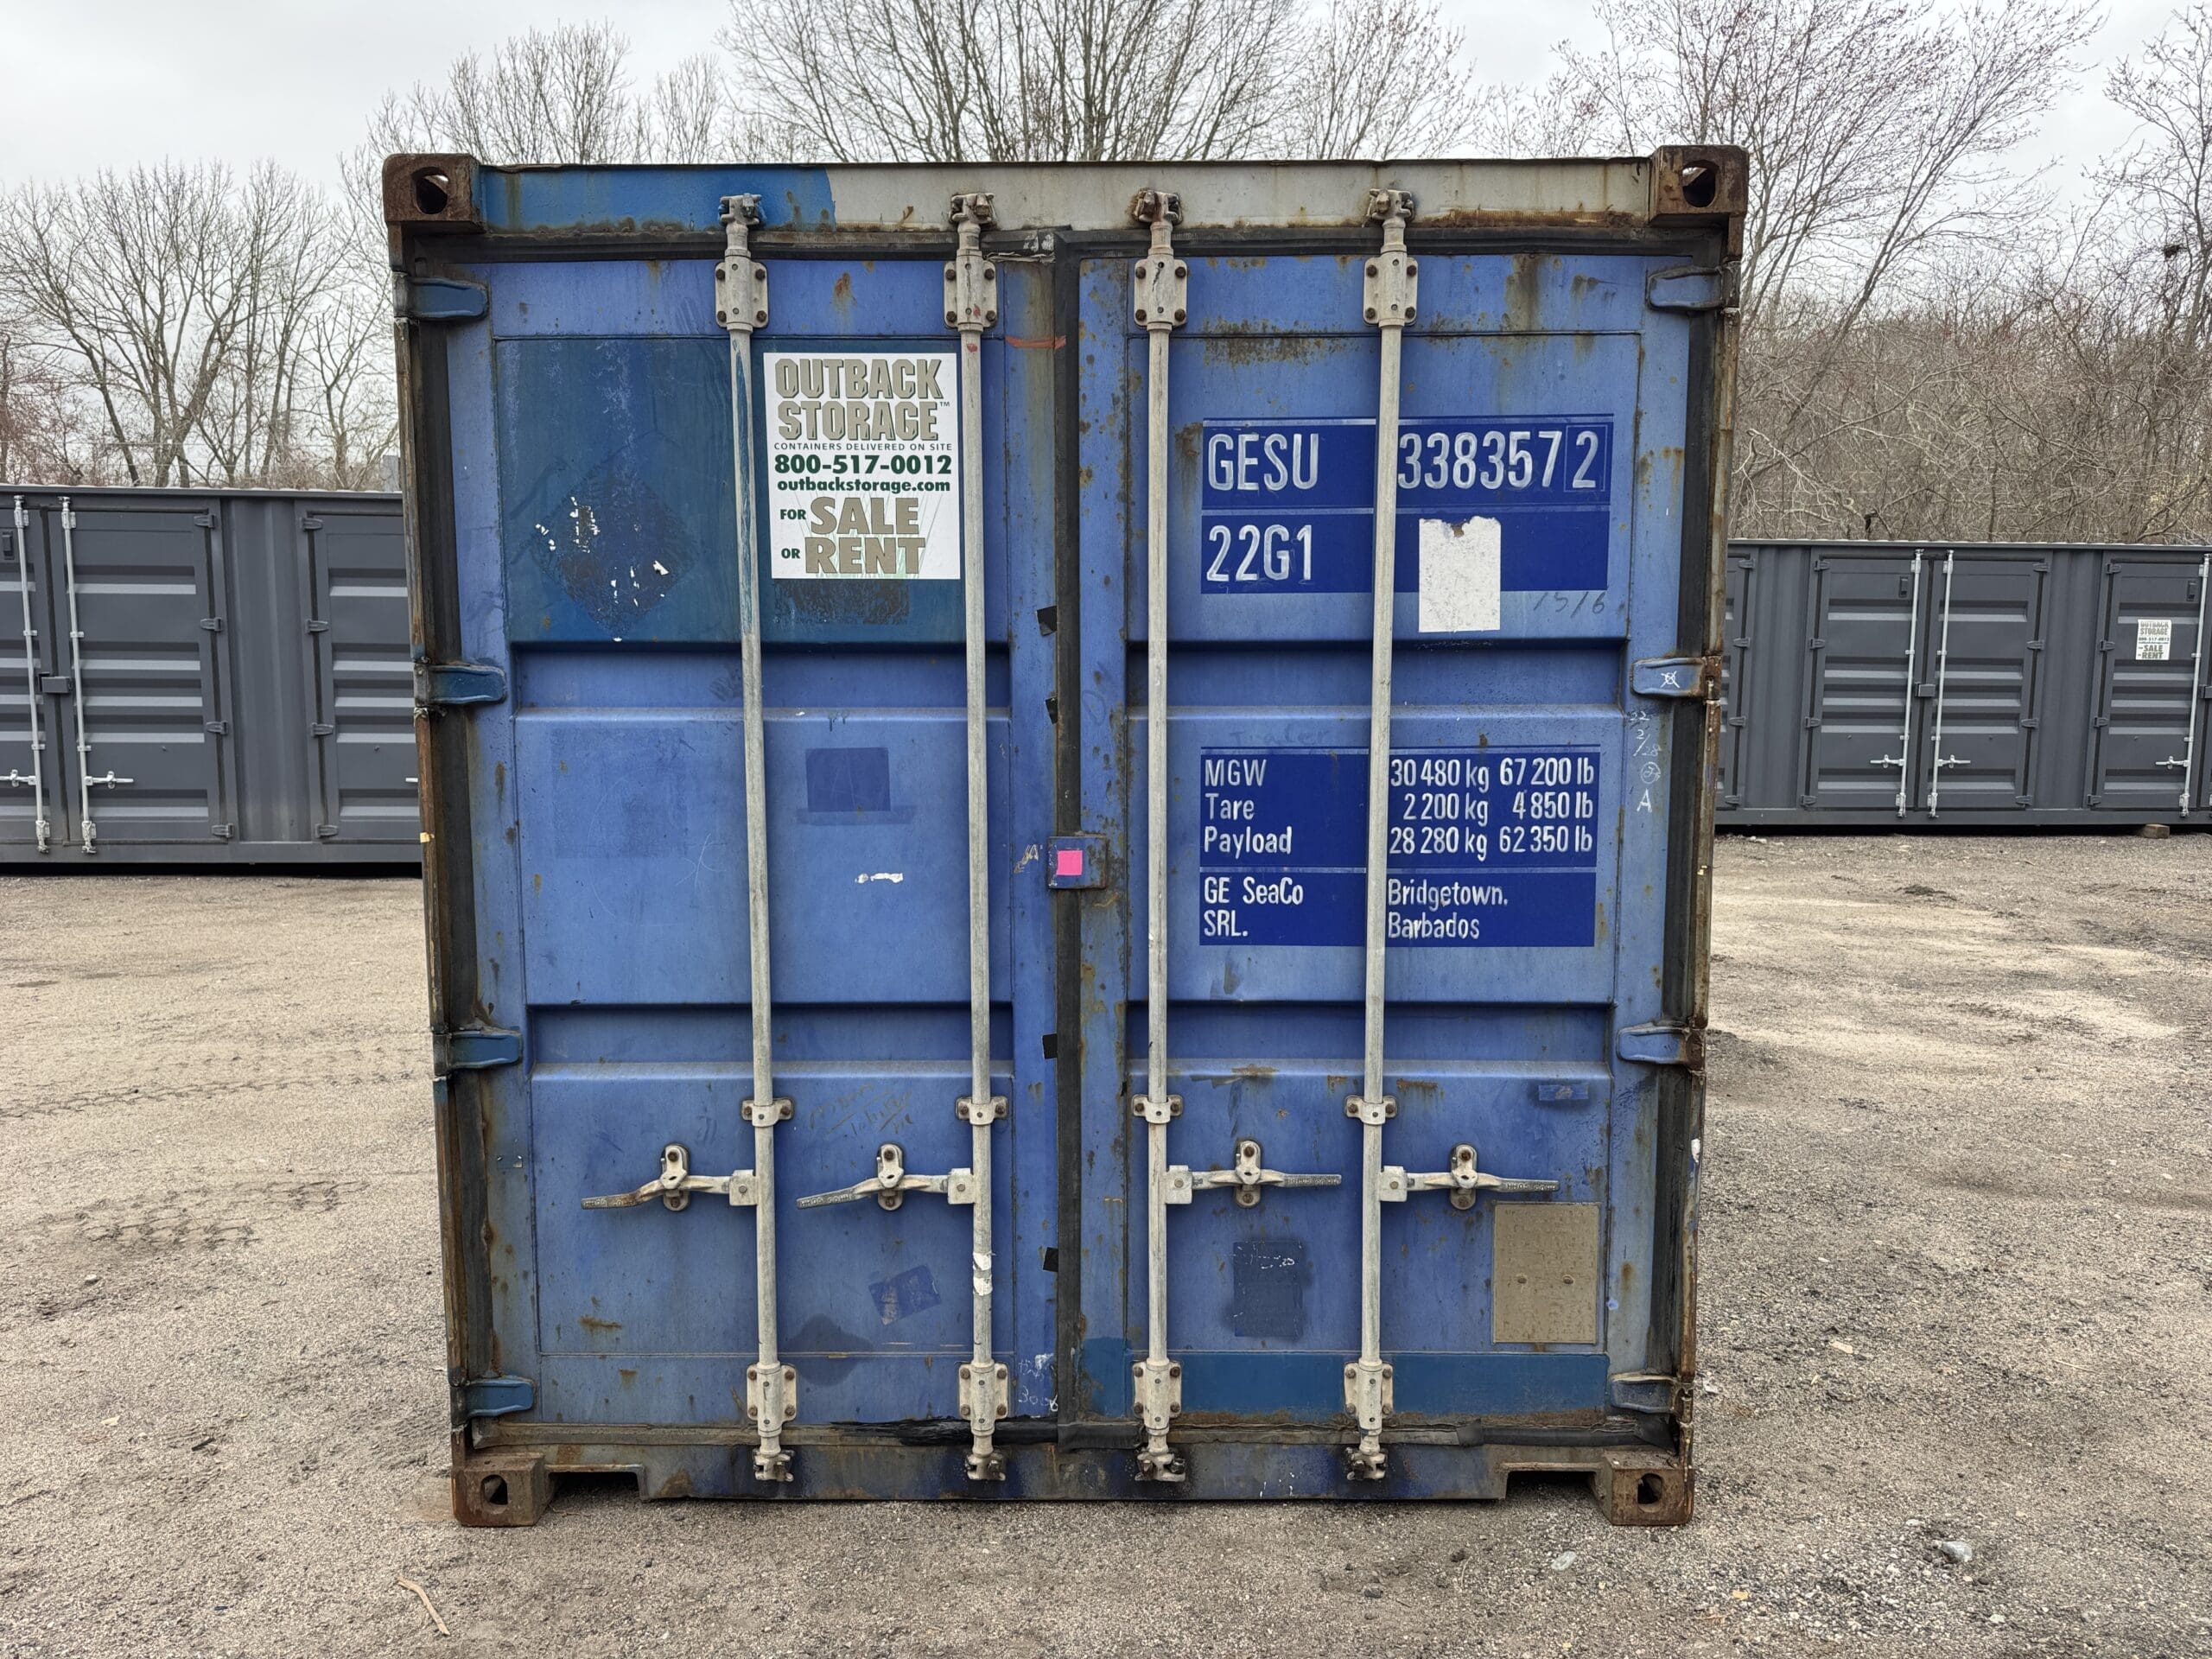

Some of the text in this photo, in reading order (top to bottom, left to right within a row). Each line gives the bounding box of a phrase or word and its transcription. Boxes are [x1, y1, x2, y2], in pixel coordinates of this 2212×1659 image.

[775, 358, 944, 399] OUTBACK
[778, 401, 938, 442] STORAGE
[774, 454, 952, 474] 800-517-0012
[846, 442, 906, 451] DELIVERED
[1208, 433, 1319, 491] GESU
[777, 476, 950, 494] outbackstorage.com
[779, 496, 919, 535] FOR SALE
[781, 537, 926, 575] OR RENT
[1206, 524, 1313, 582] 22G1
[1205, 760, 1267, 787] MGW
[1466, 760, 1490, 793] kg
[1576, 757, 1594, 785] lb
[1205, 792, 1255, 820] Tare
[1465, 793, 1489, 826] kg
[1575, 792, 1593, 818] lb
[1204, 826, 1293, 859] Payload
[1465, 827, 1488, 861] kg
[1574, 825, 1592, 852] lb
[1204, 877, 1304, 905] GE SeaCo
[1388, 878, 1509, 912] Bridgetown.
[1203, 910, 1249, 938] SRL.
[1388, 912, 1480, 940] Barbados
